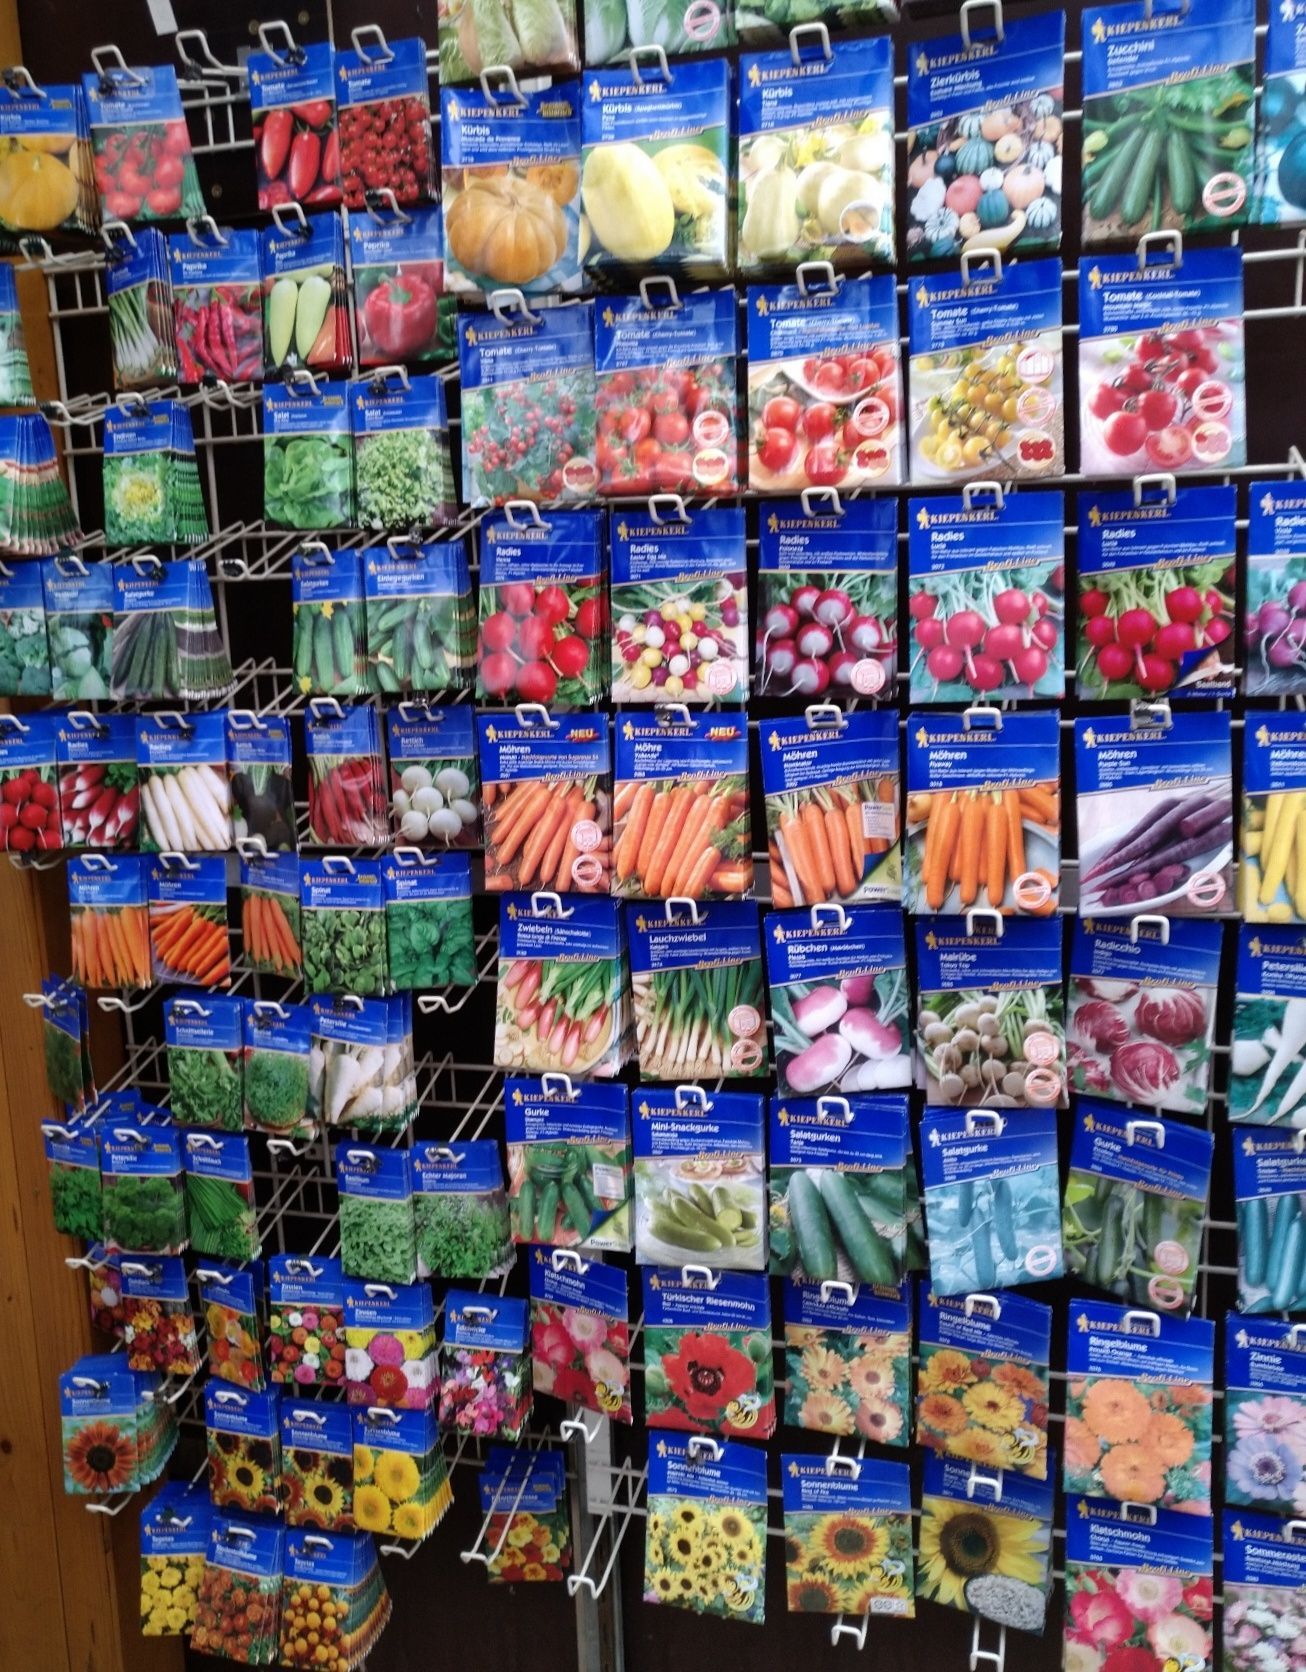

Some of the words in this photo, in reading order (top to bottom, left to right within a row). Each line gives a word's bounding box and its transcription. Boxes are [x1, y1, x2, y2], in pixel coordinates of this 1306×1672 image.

[1107, 39, 1155, 55] Zucchini
[762, 86, 793, 99] Kürbis
[602, 102, 632, 114] Kürbis
[461, 124, 490, 136] Kürbis
[1102, 290, 1143, 303] Tomate
[931, 307, 968, 320] Tomate
[770, 317, 805, 327] Tomate
[616, 329, 650, 341] Tomate
[480, 346, 512, 359] Tomate
[779, 535, 810, 546] Radies
[930, 531, 965, 543] Radies
[1101, 529, 1136, 540] Radies
[496, 546, 521, 557] Radies
[630, 543, 659, 554] Radies
[570, 728, 594, 740] NEU
[710, 727, 736, 738] NEU
[499, 744, 531, 754] Möhren
[635, 742, 662, 753] Möhre
[783, 749, 818, 762] Möhren
[929, 750, 967, 760] Möhren
[1098, 749, 1138, 761] Möhren
[517, 923, 553, 935] Zwiebeln
[649, 932, 707, 943] Lauchzwiebel
[787, 943, 828, 954] Rübchen
[1094, 939, 1141, 955] Radicchio
[939, 952, 976, 962] Mairübe
[524, 1107, 549, 1117] Gurke
[651, 1121, 720, 1134] Mini-Snackgurke
[790, 1129, 841, 1143] Salatgurken
[1094, 1137, 1122, 1151] Gurke
[941, 1143, 989, 1158] Salatgurke
[544, 1268, 586, 1291] Klatschmohn
[662, 1292, 704, 1305] Türkischer
[705, 1295, 756, 1312] Riesenmohn
[939, 1311, 992, 1332] Ringelblume
[1089, 1336, 1148, 1353] Ringelblume
[1250, 1351, 1282, 1364] Zinnie
[801, 1479, 859, 1492] Sonnenblume
[1090, 1522, 1151, 1544] Klatschmohn
